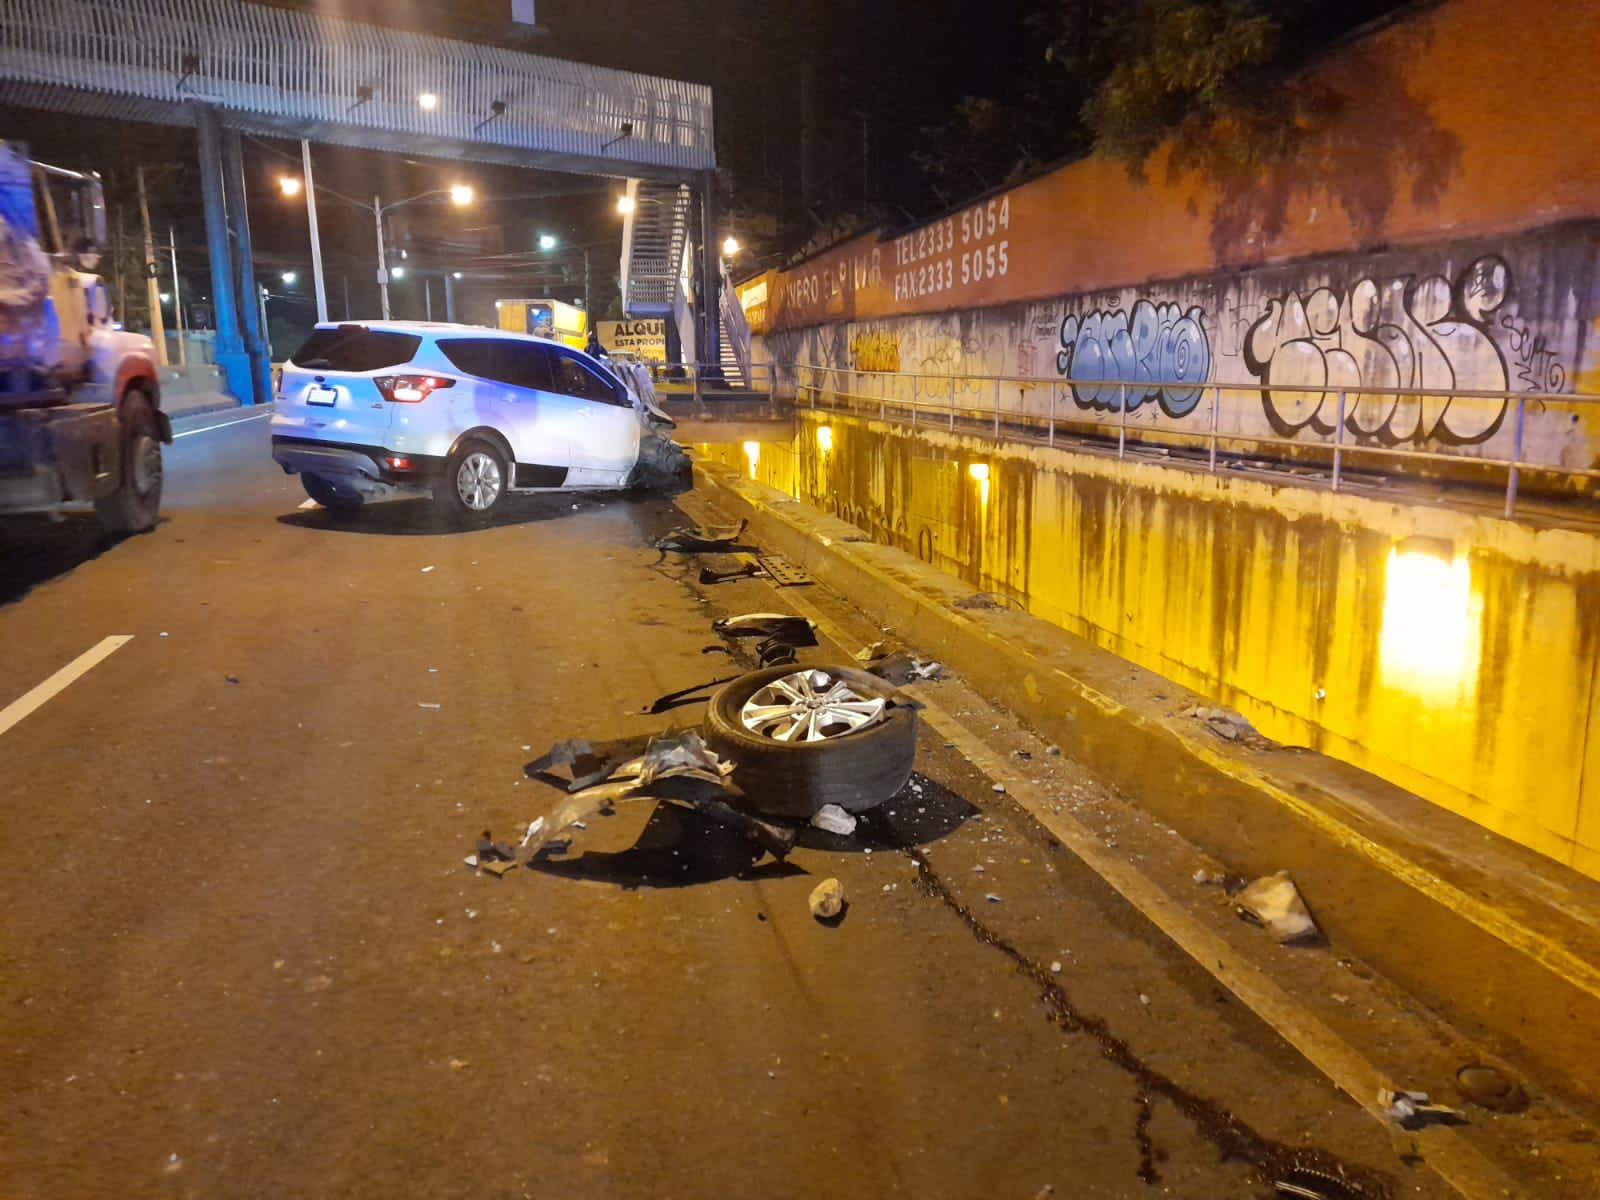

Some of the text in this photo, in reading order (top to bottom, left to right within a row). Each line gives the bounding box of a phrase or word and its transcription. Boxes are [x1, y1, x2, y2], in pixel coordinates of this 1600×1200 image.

[961, 194, 1009, 244] 5054
[961, 240, 1009, 285] 5055
[615, 338, 636, 347] ESTA
